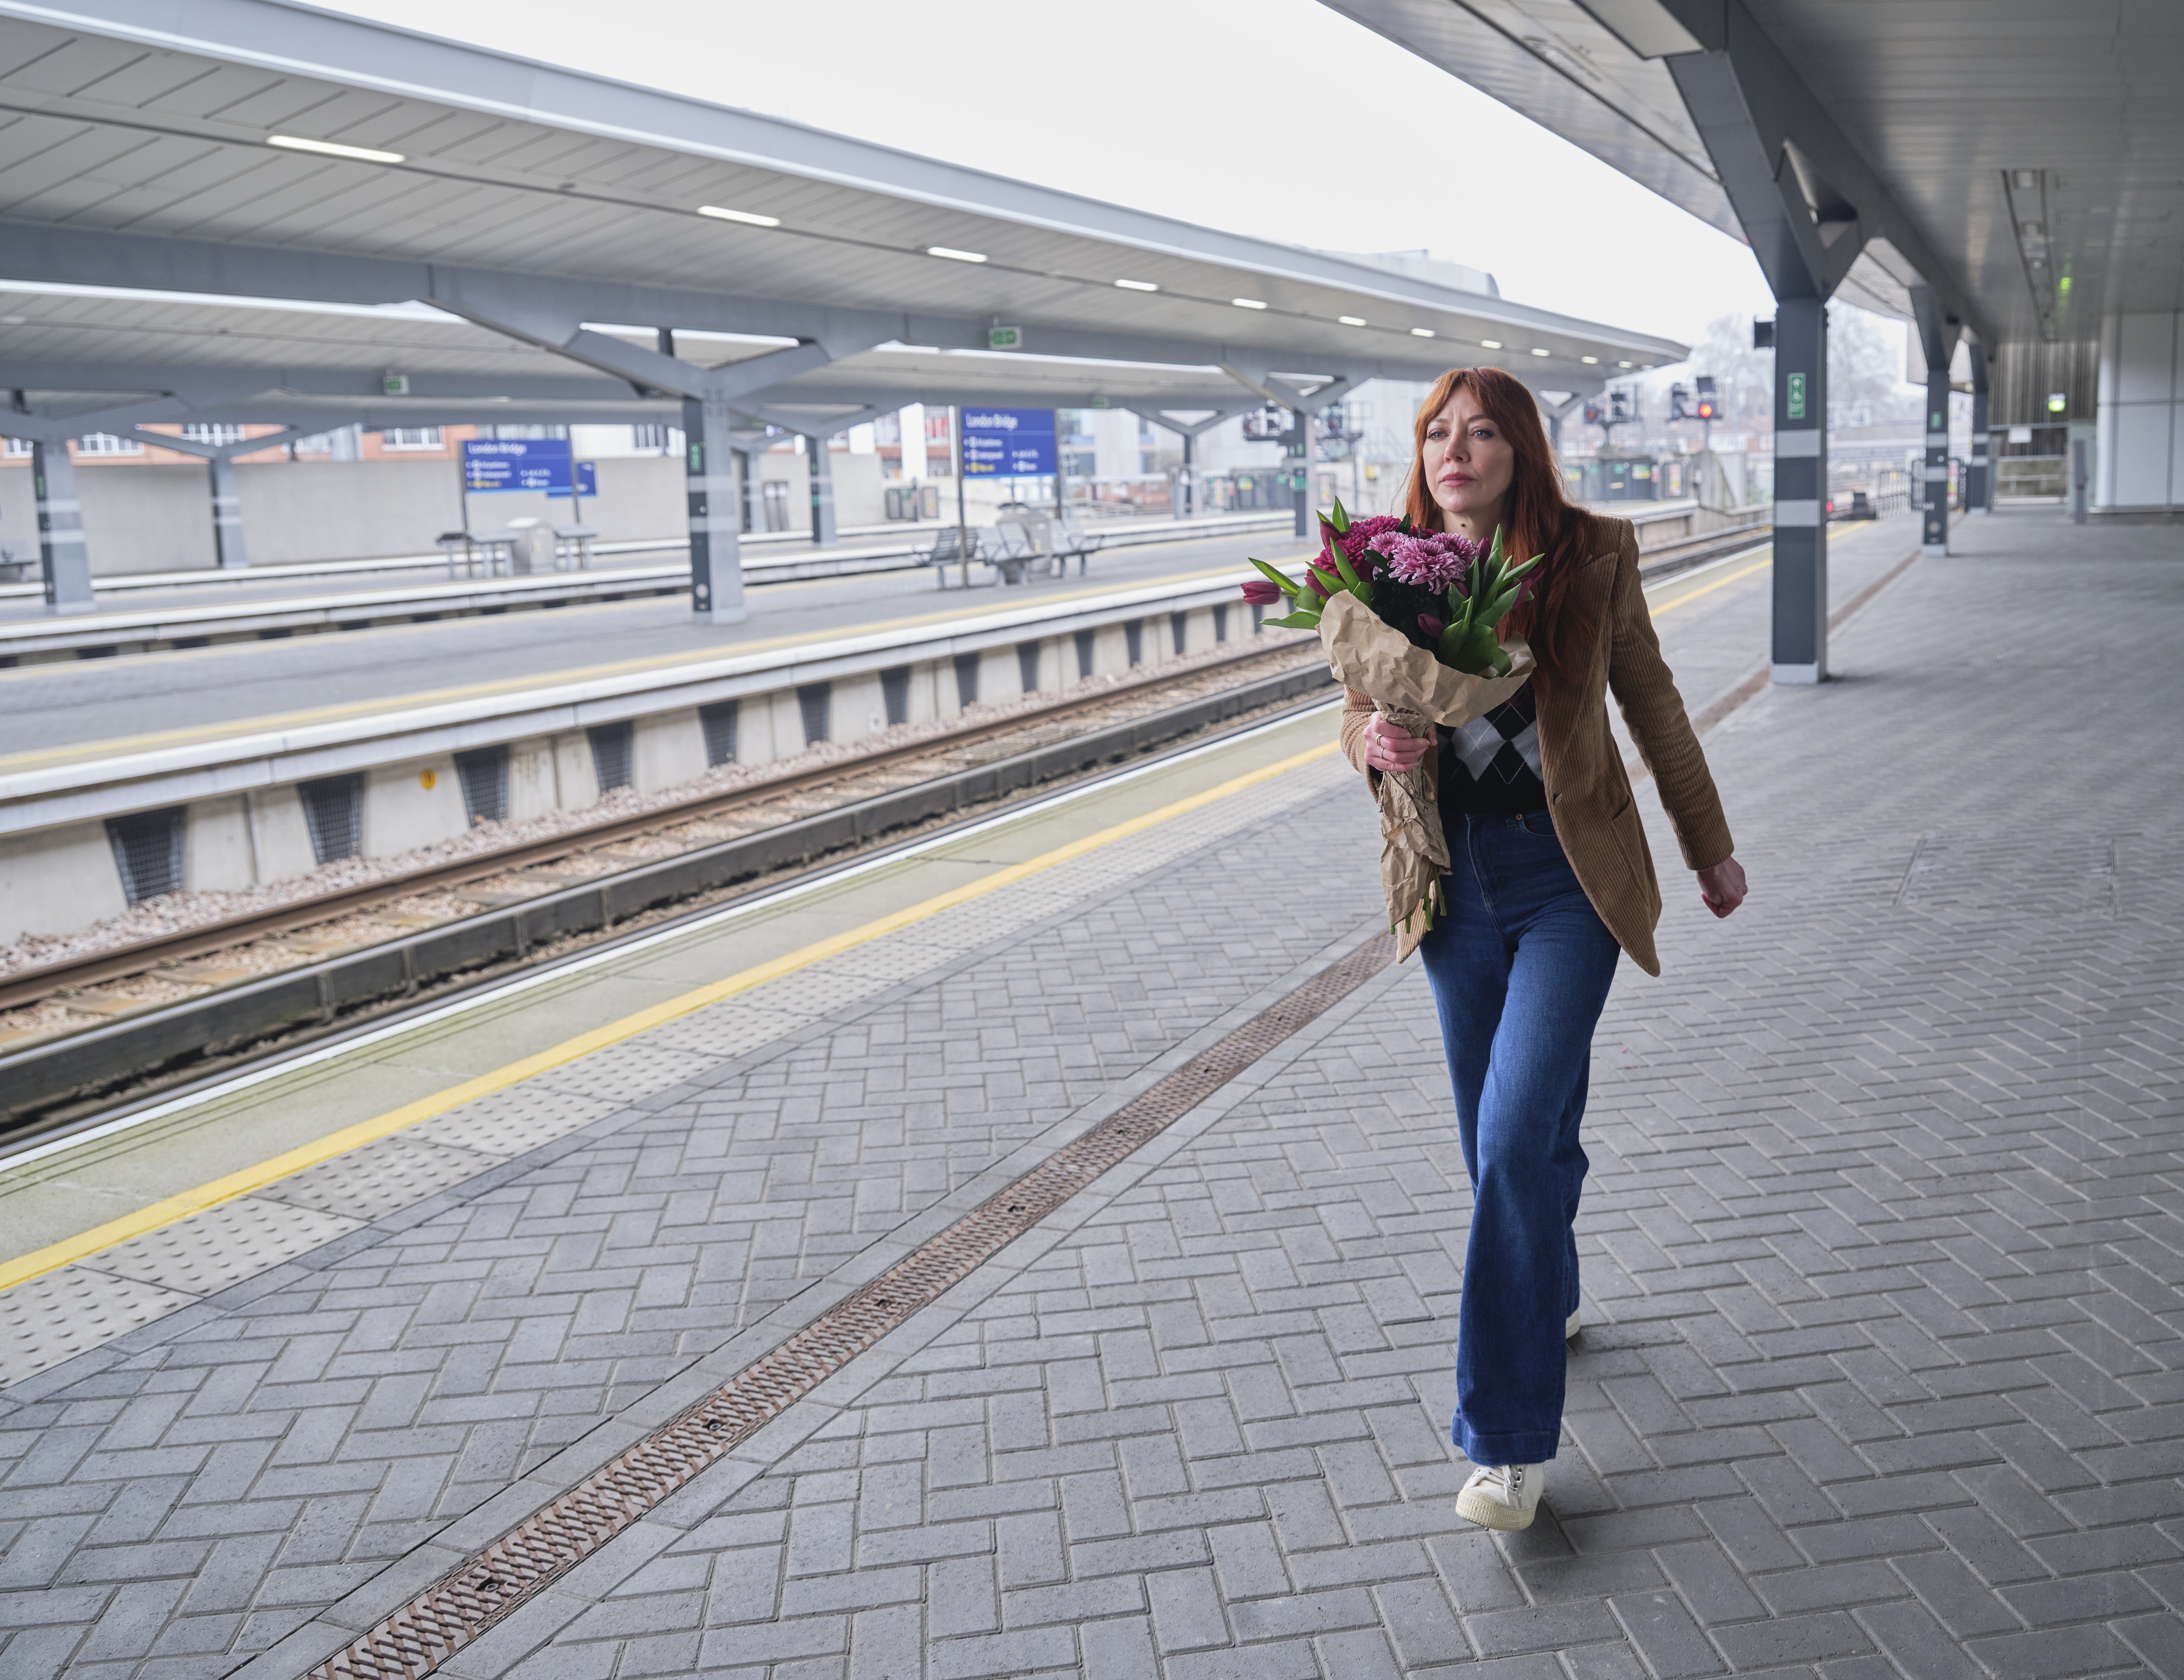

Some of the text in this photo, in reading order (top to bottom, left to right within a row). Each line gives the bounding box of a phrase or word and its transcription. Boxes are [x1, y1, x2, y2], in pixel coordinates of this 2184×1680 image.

[966, 413, 1018, 430] London Bridge
[469, 442, 526, 455] London Bridge
